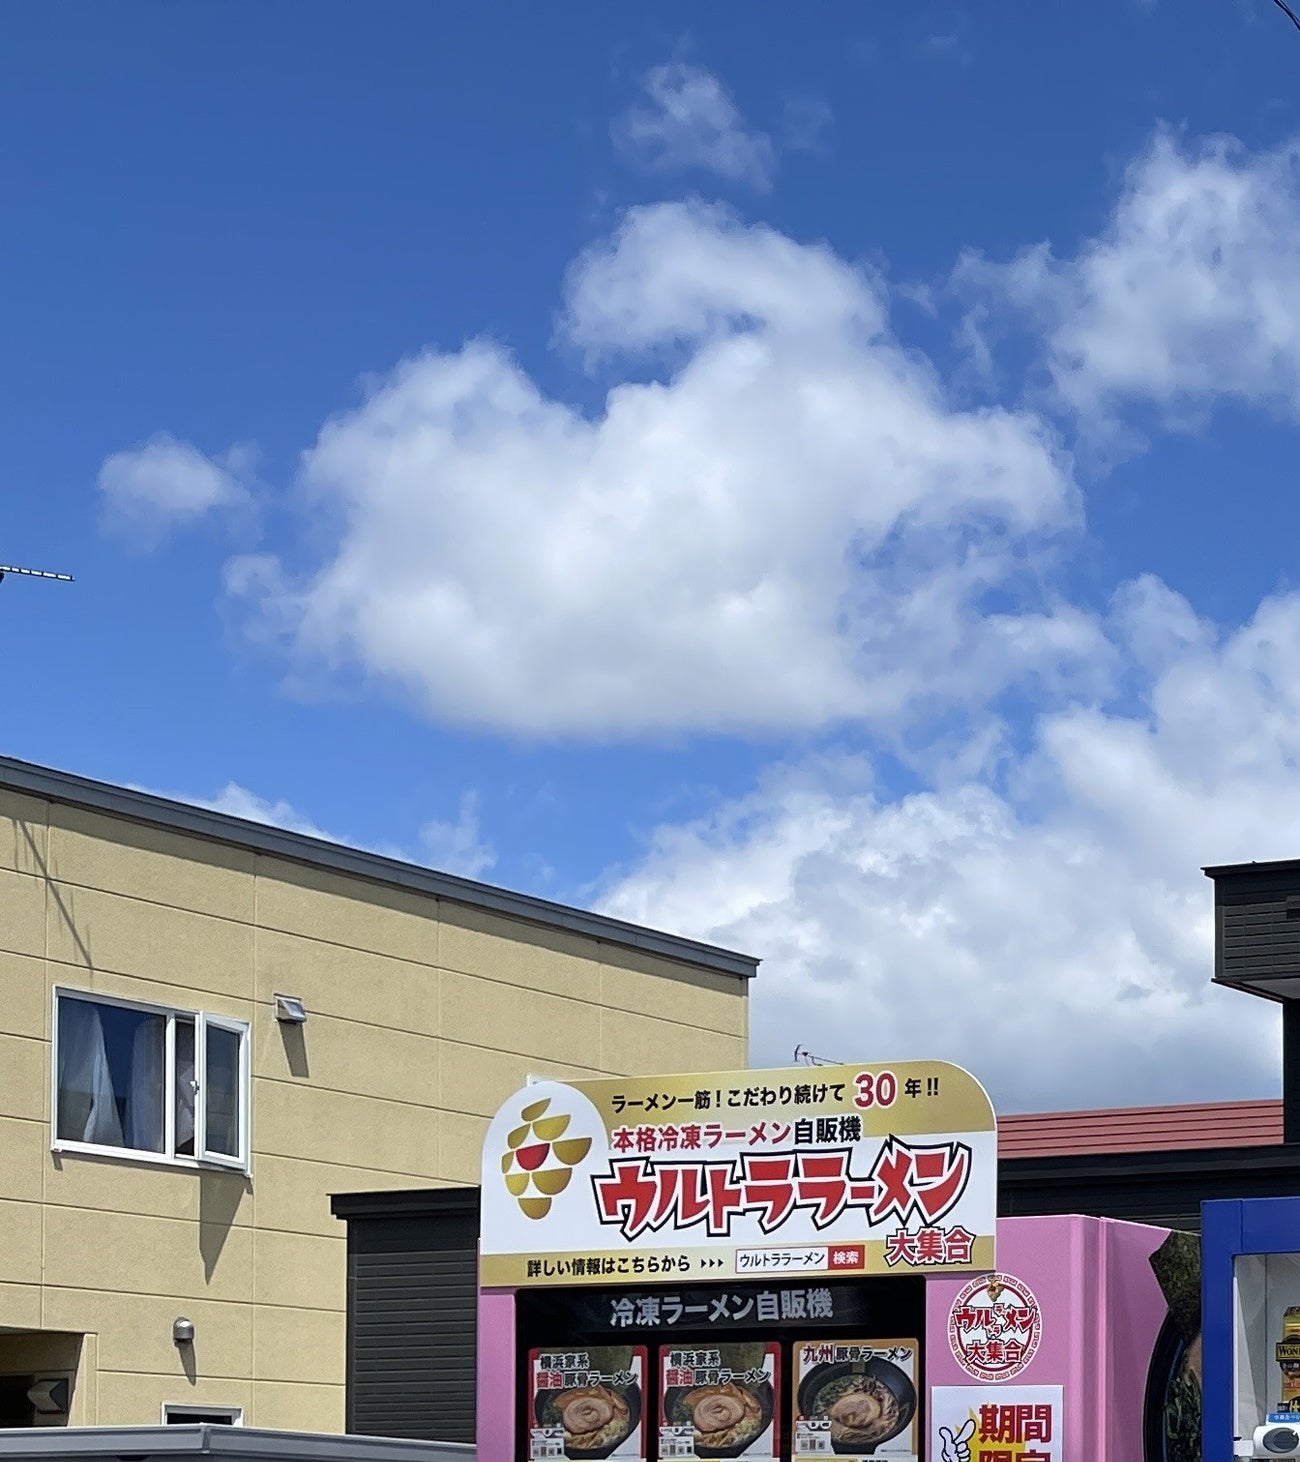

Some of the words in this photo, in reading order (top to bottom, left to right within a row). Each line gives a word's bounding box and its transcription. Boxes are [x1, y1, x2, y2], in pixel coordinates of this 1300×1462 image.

[612, 1117, 862, 1153] 本格冷凍ラーメン自販機
[590, 1134, 972, 1242] ウルトララーメン
[739, 1250, 825, 1268] ウルトララーメン
[832, 1250, 860, 1266] 検索
[885, 1226, 975, 1266] 大集合
[527, 1254, 690, 1278] 詳しい情報はこちらから
[609, 1289, 834, 1328] 冷凍ラーメン自販機
[966, 1340, 1024, 1364] 大集合
[978, 1404, 1052, 1444] 期間
